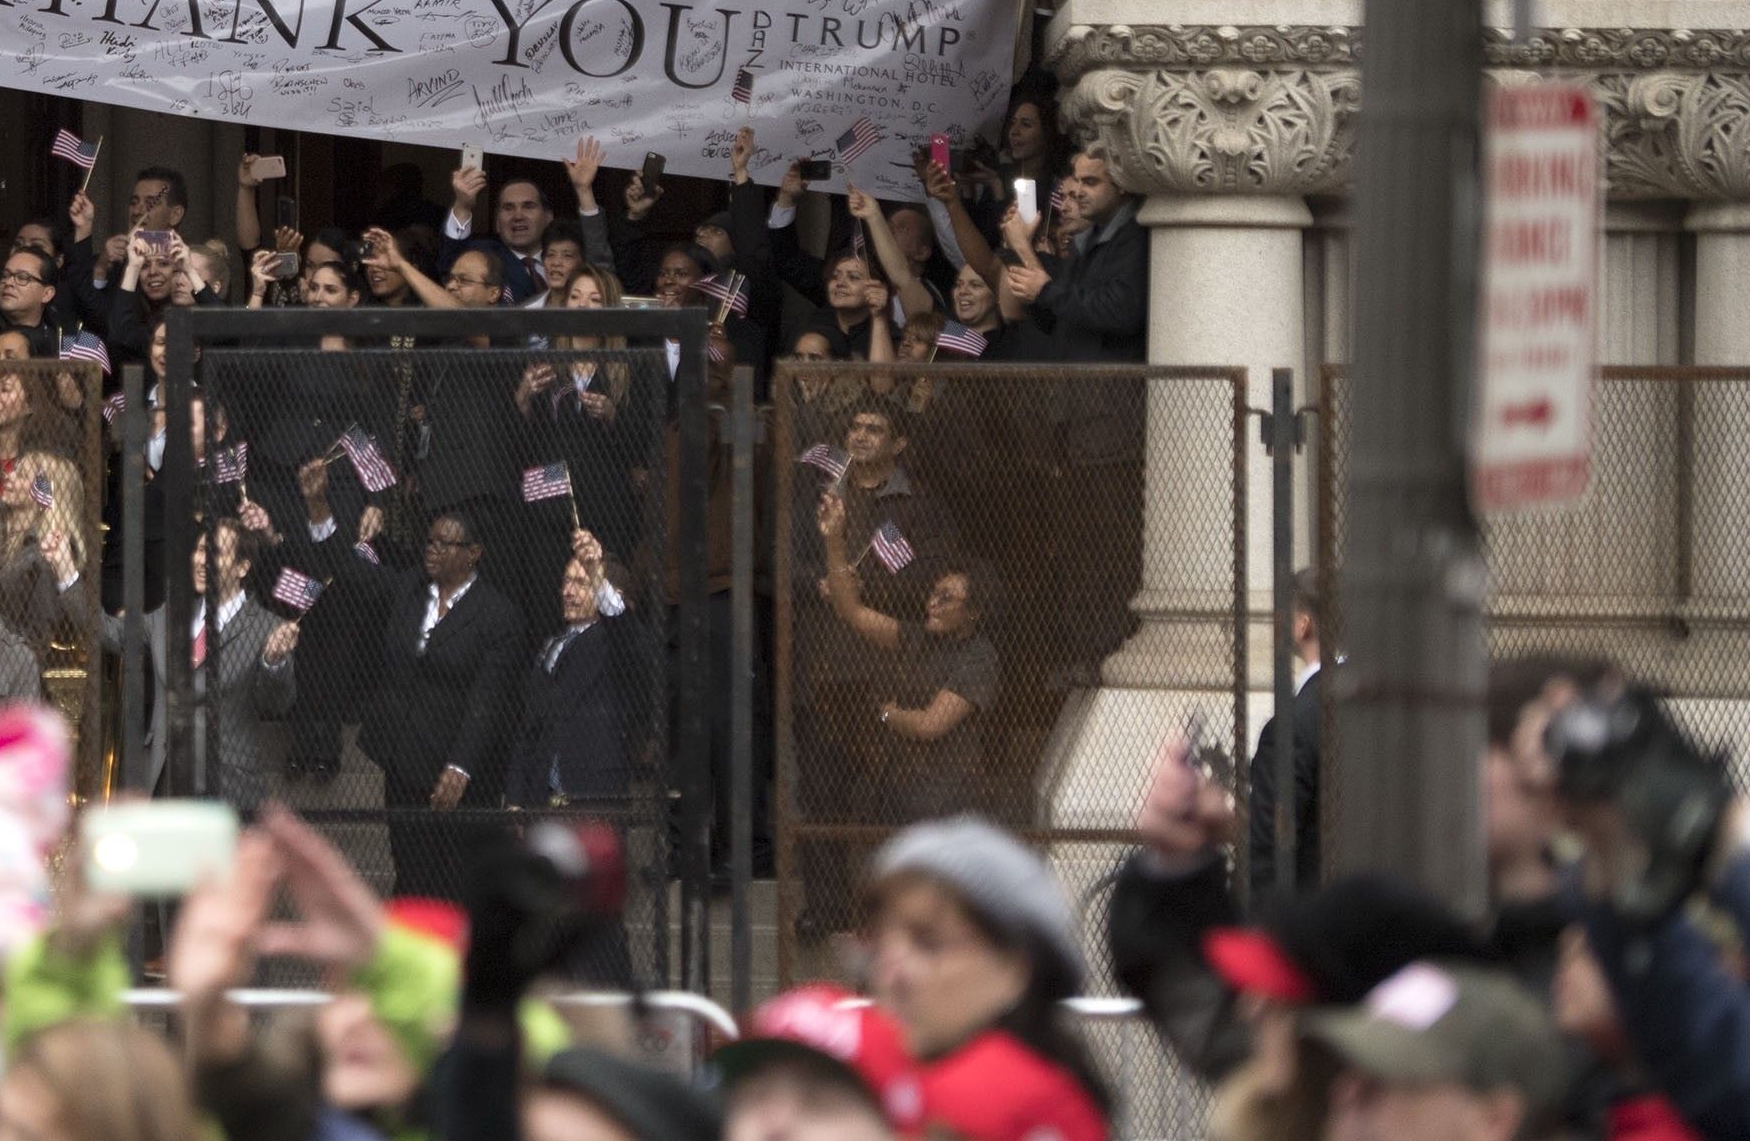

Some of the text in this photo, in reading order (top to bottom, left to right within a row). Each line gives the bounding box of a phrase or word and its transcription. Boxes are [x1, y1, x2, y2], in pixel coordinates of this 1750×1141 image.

[100, 29, 138, 48] Heidi
[406, 67, 462, 105] ARVIND
[779, 59, 900, 82] INTERNATIONAL
[906, 72, 958, 88] HOTEL
